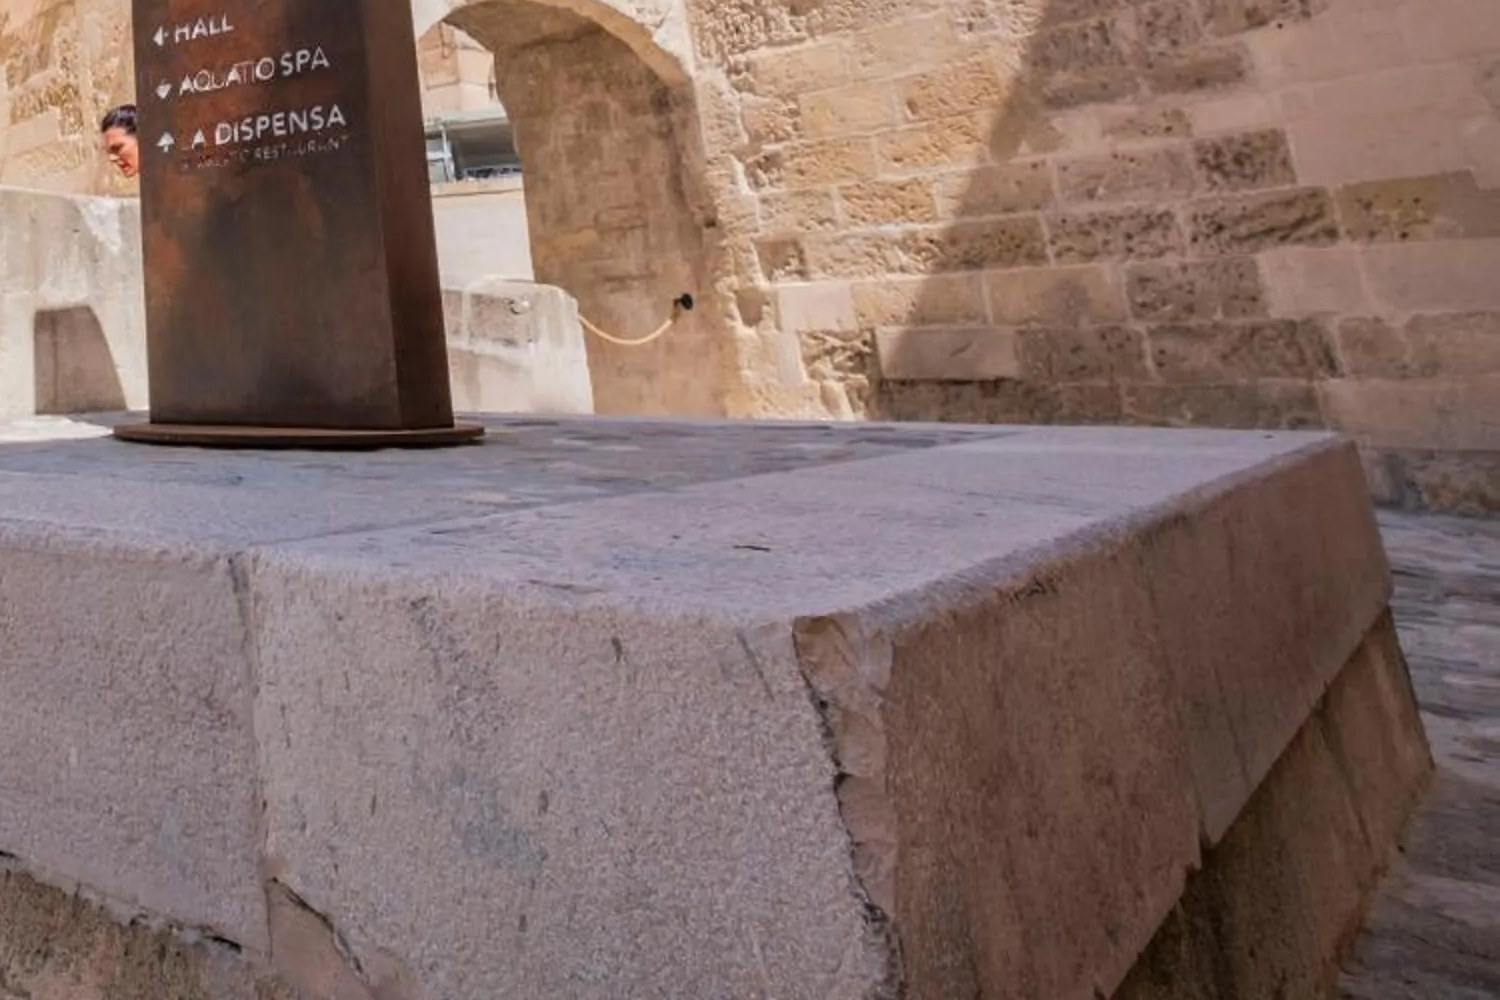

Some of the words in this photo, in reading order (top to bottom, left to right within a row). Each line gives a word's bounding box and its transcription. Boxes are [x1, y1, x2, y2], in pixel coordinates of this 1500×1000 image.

[174, 12, 234, 43] HALL
[280, 46, 329, 76] SPA
[215, 103, 347, 145] DISPENSA
